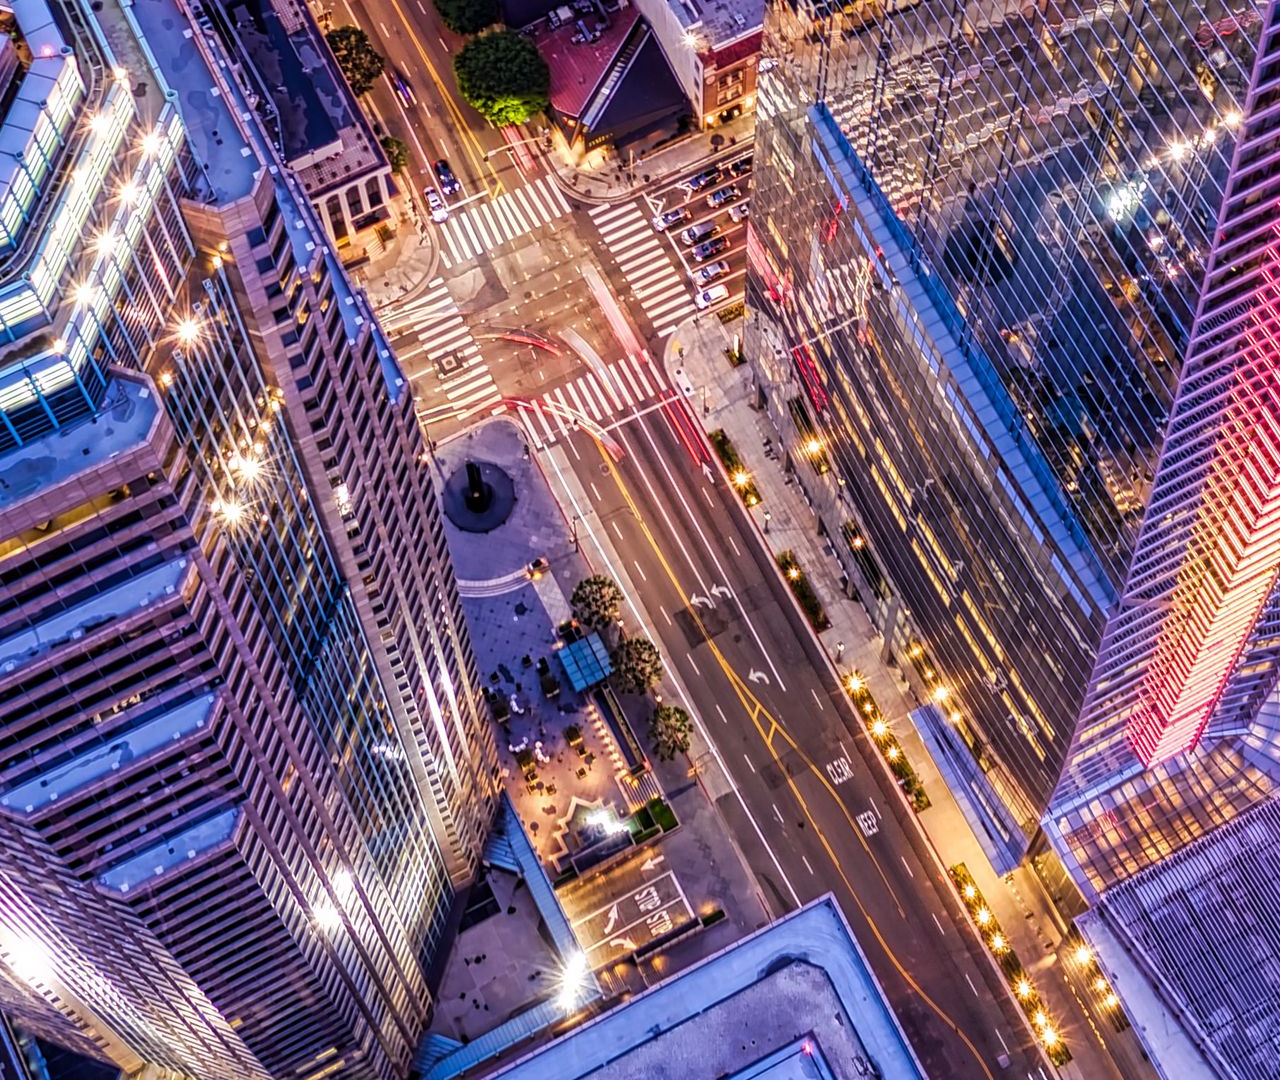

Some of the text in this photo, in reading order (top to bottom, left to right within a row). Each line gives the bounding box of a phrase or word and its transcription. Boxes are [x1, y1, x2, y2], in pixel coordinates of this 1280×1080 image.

[826, 757, 854, 786] CLEAR
[856, 810, 880, 838] KEEP
[634, 886, 661, 913] STOP
[646, 910, 673, 937] STOP
